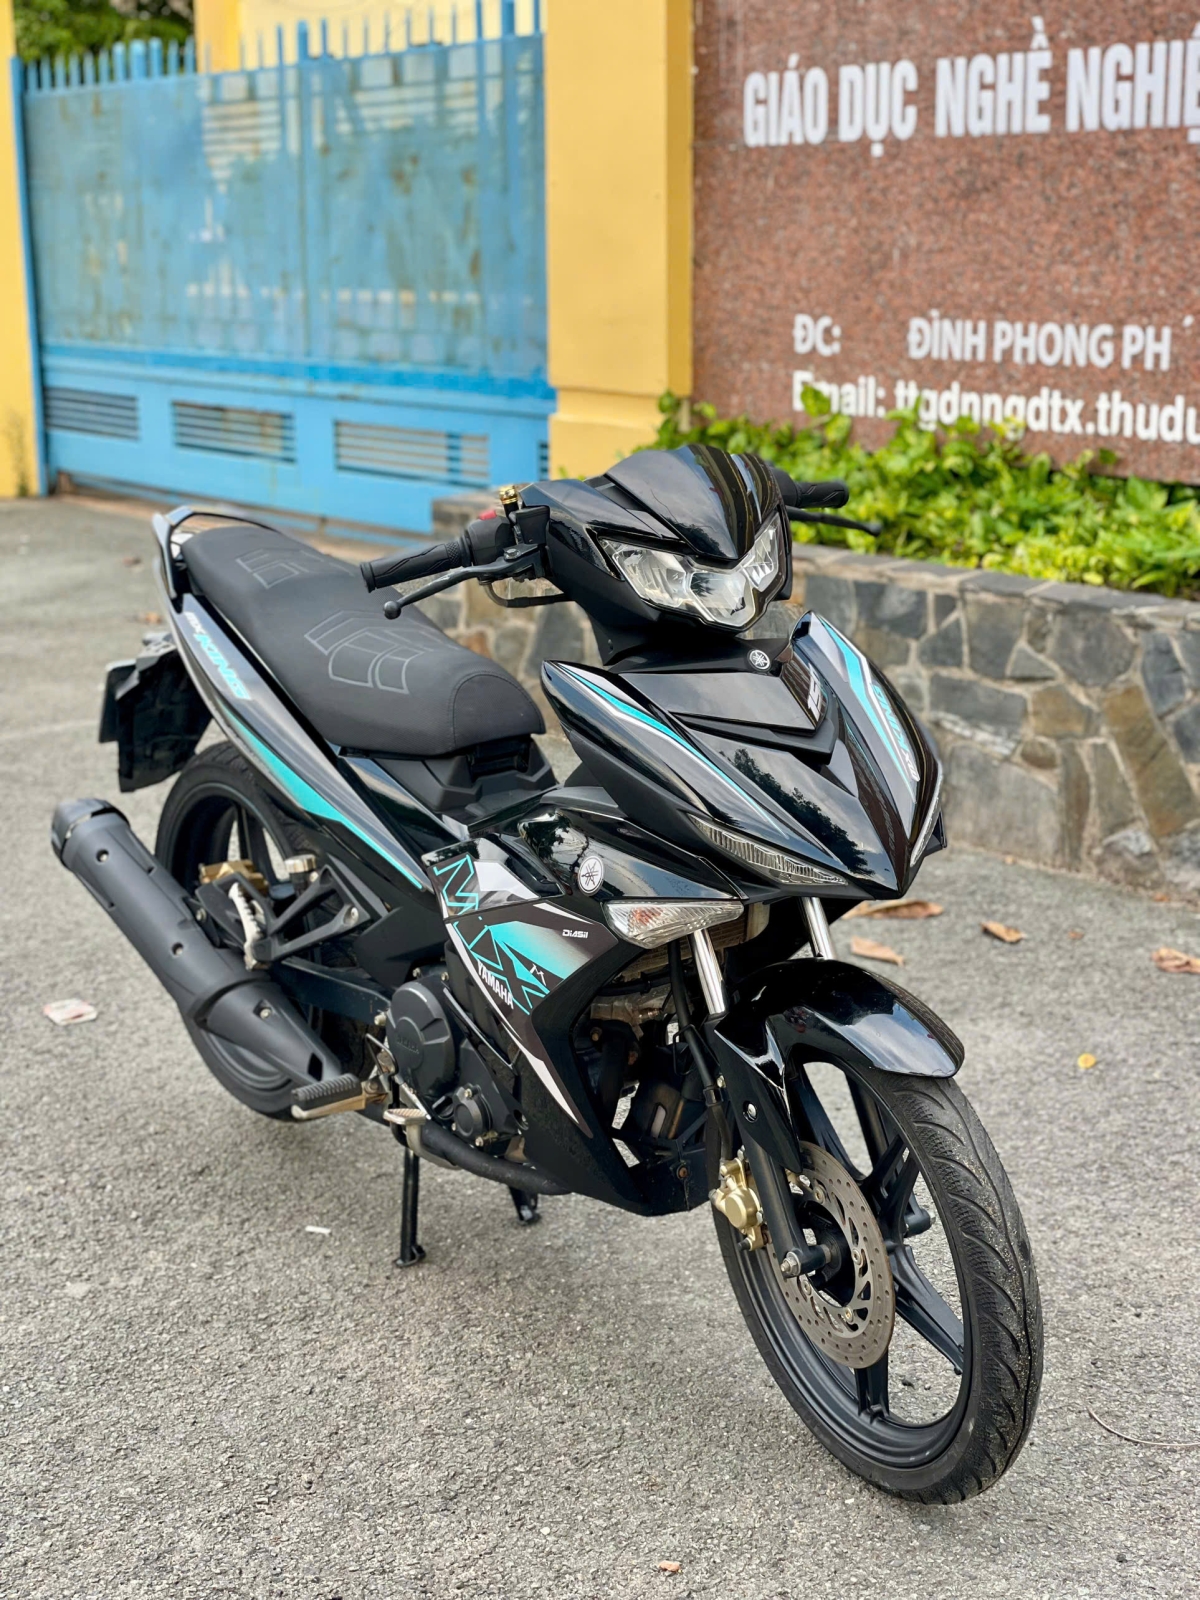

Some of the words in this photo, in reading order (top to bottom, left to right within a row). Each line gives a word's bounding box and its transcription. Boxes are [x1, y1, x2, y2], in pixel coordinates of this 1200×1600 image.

[743, 53, 829, 148] GIÁO
[838, 59, 918, 158] DỤC
[935, 16, 1052, 137] NGHỀ
[793, 313, 842, 357] ĐC:
[992, 320, 1114, 369] PHONG
[1121, 315, 1194, 371] PH
[477, 959, 514, 1010] YAMAHA
